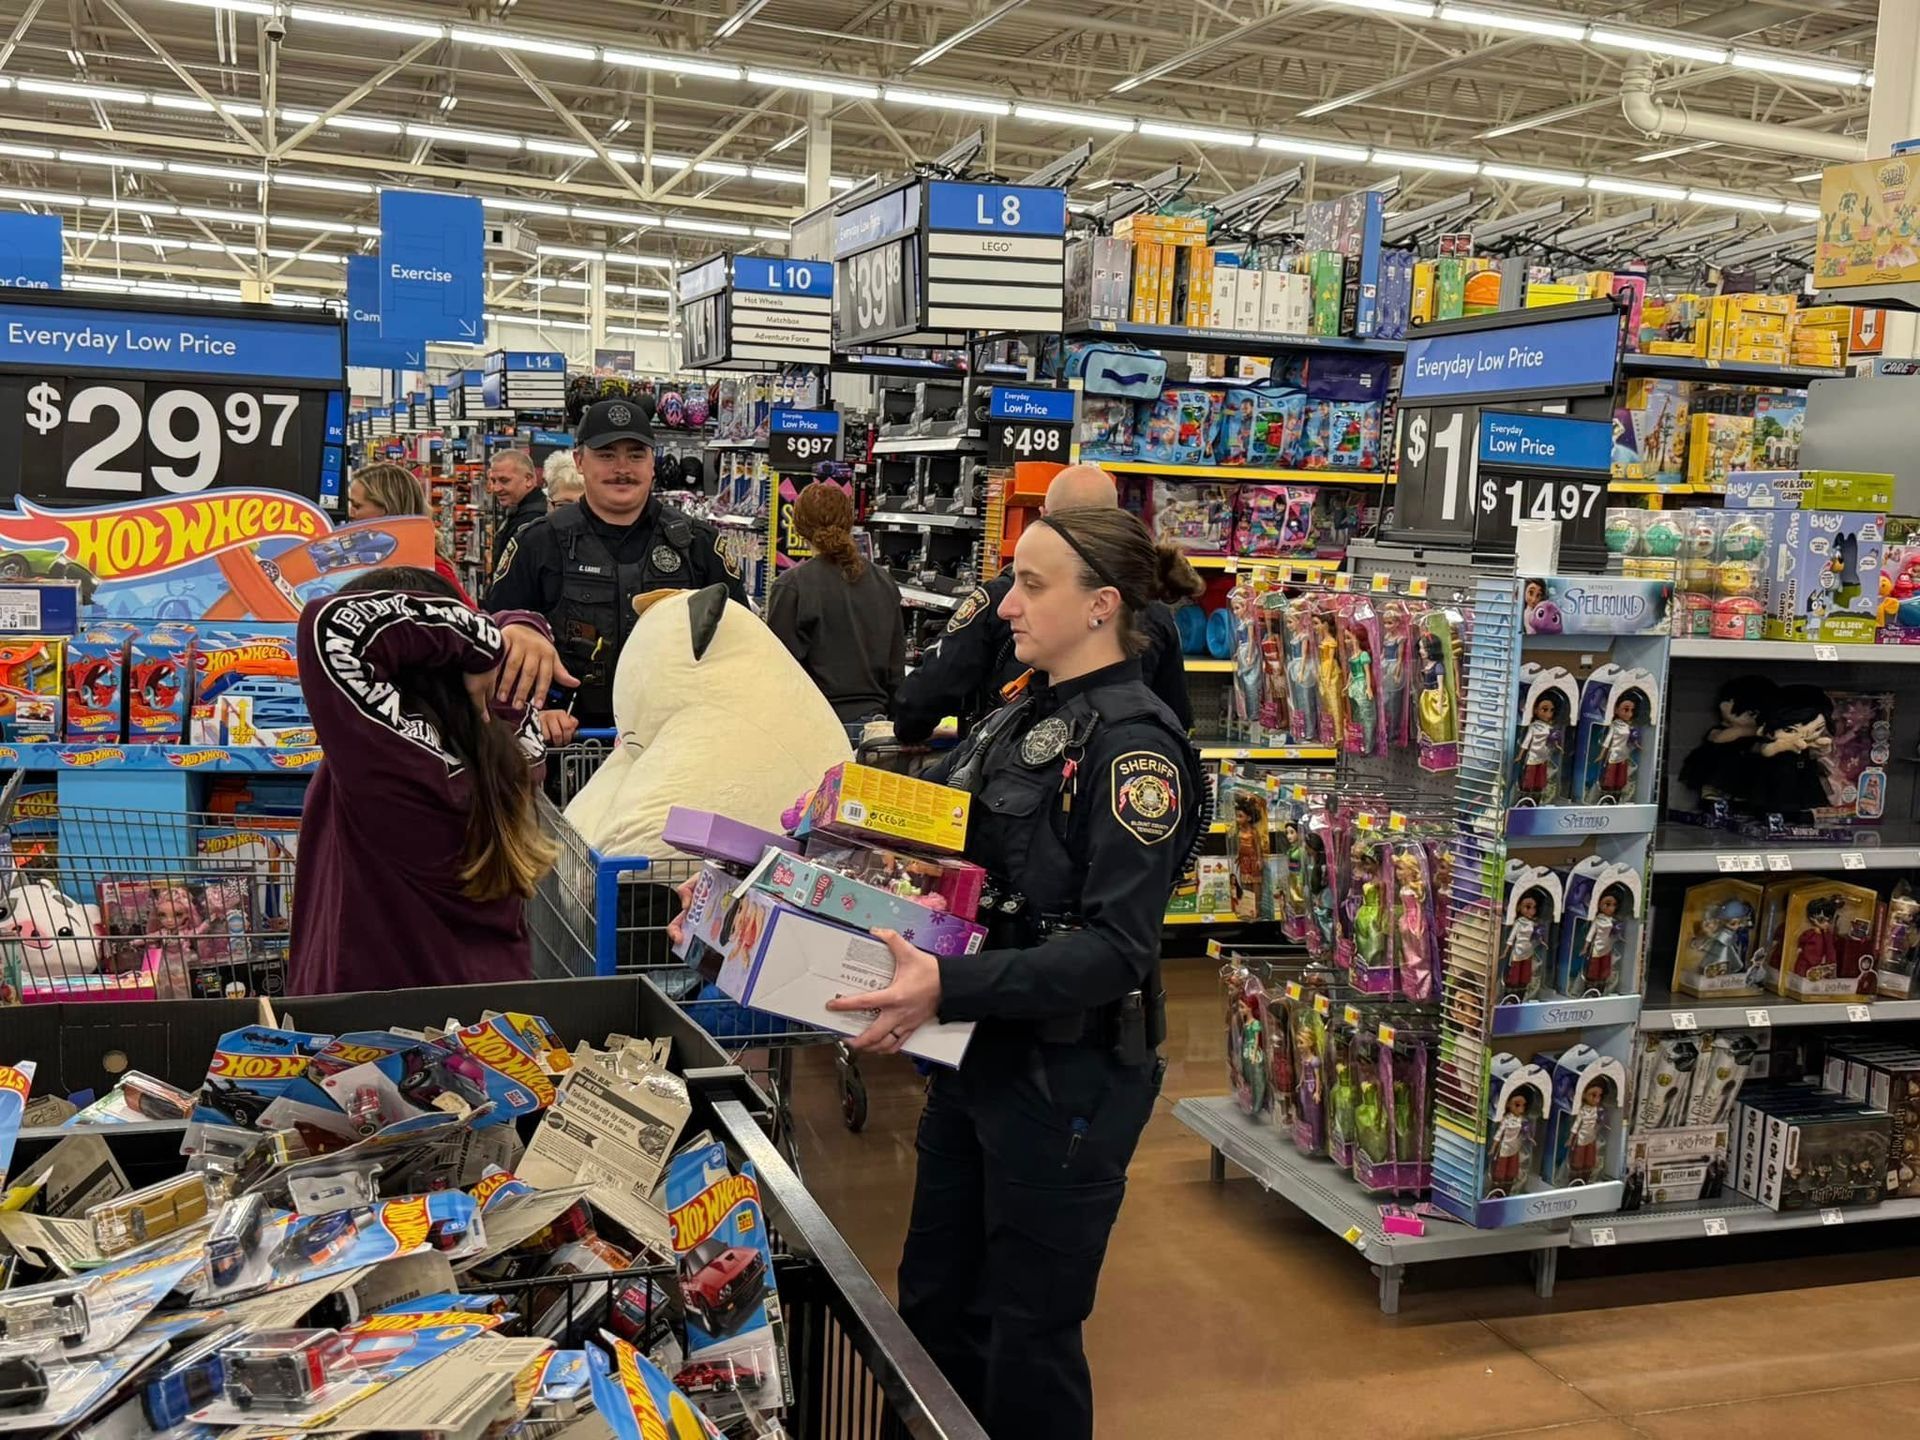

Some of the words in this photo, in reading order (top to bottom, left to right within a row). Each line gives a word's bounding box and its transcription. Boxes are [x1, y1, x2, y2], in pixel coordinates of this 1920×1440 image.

[977, 193, 994, 225] L
[1001, 195, 1020, 226] 8
[391, 264, 452, 282] Exercise
[768, 265, 781, 288] L
[786, 266, 812, 290] 10
[15, 276, 49, 290] Care
[744, 295, 757, 304] Hot
[759, 296, 784, 306] Wheels
[353, 309, 381, 323] Cam
[766, 316, 800, 325] Matchbox
[9, 323, 118, 355] Everyday
[126, 329, 171, 351] Low
[179, 333, 237, 356] Price
[754, 332, 790, 341] Adventure
[791, 335, 811, 343] Force
[526, 355, 534, 368] L
[536, 355, 551, 368] 14
[1416, 353, 1474, 381] Everyday
[1478, 351, 1504, 371] Low
[1508, 346, 1544, 368] Price
[1004, 392, 1030, 401] Everyday
[1004, 403, 1022, 413] Low
[1024, 404, 1048, 415] Price
[782, 420, 797, 429] Low
[799, 421, 818, 430] Price
[1490, 423, 1523, 436] Everyday
[1490, 436, 1516, 453] Low
[1520, 438, 1555, 456] Price
[326, 478, 334, 488] 5
[56, 514, 165, 576] HOT
[154, 498, 317, 565] WHEELS
[1559, 587, 1646, 621] SPELLBOUND
[1119, 758, 1174, 778] SHERIFF
[225, 1055, 280, 1078] HOT
[673, 1203, 707, 1250] HOT
[703, 1176, 755, 1232] WHEELS
